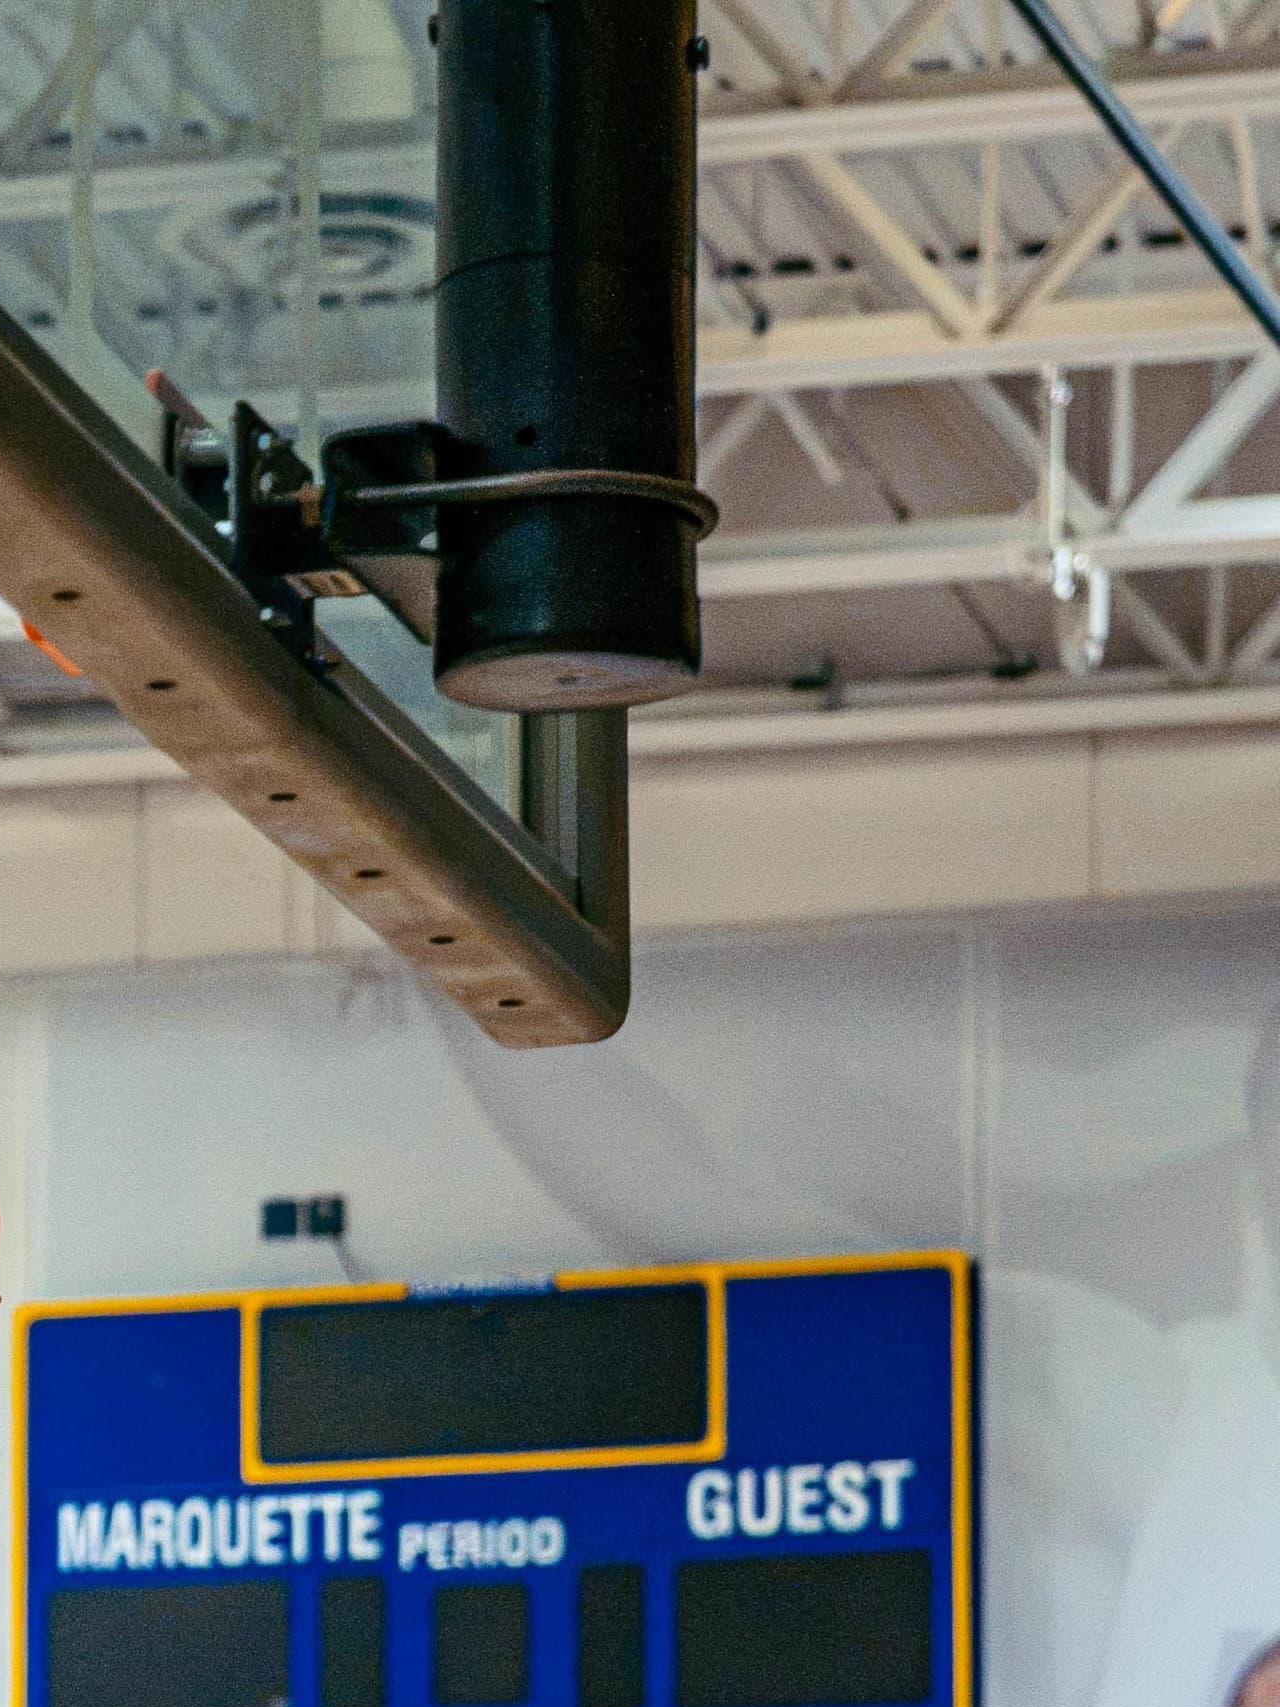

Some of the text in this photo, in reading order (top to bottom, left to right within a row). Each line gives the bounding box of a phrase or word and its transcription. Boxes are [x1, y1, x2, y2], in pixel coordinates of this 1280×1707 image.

[57, 1491, 382, 1572] MARQUETTE
[685, 1459, 916, 1540] GUEST
[398, 1518, 566, 1573] PERIOD
